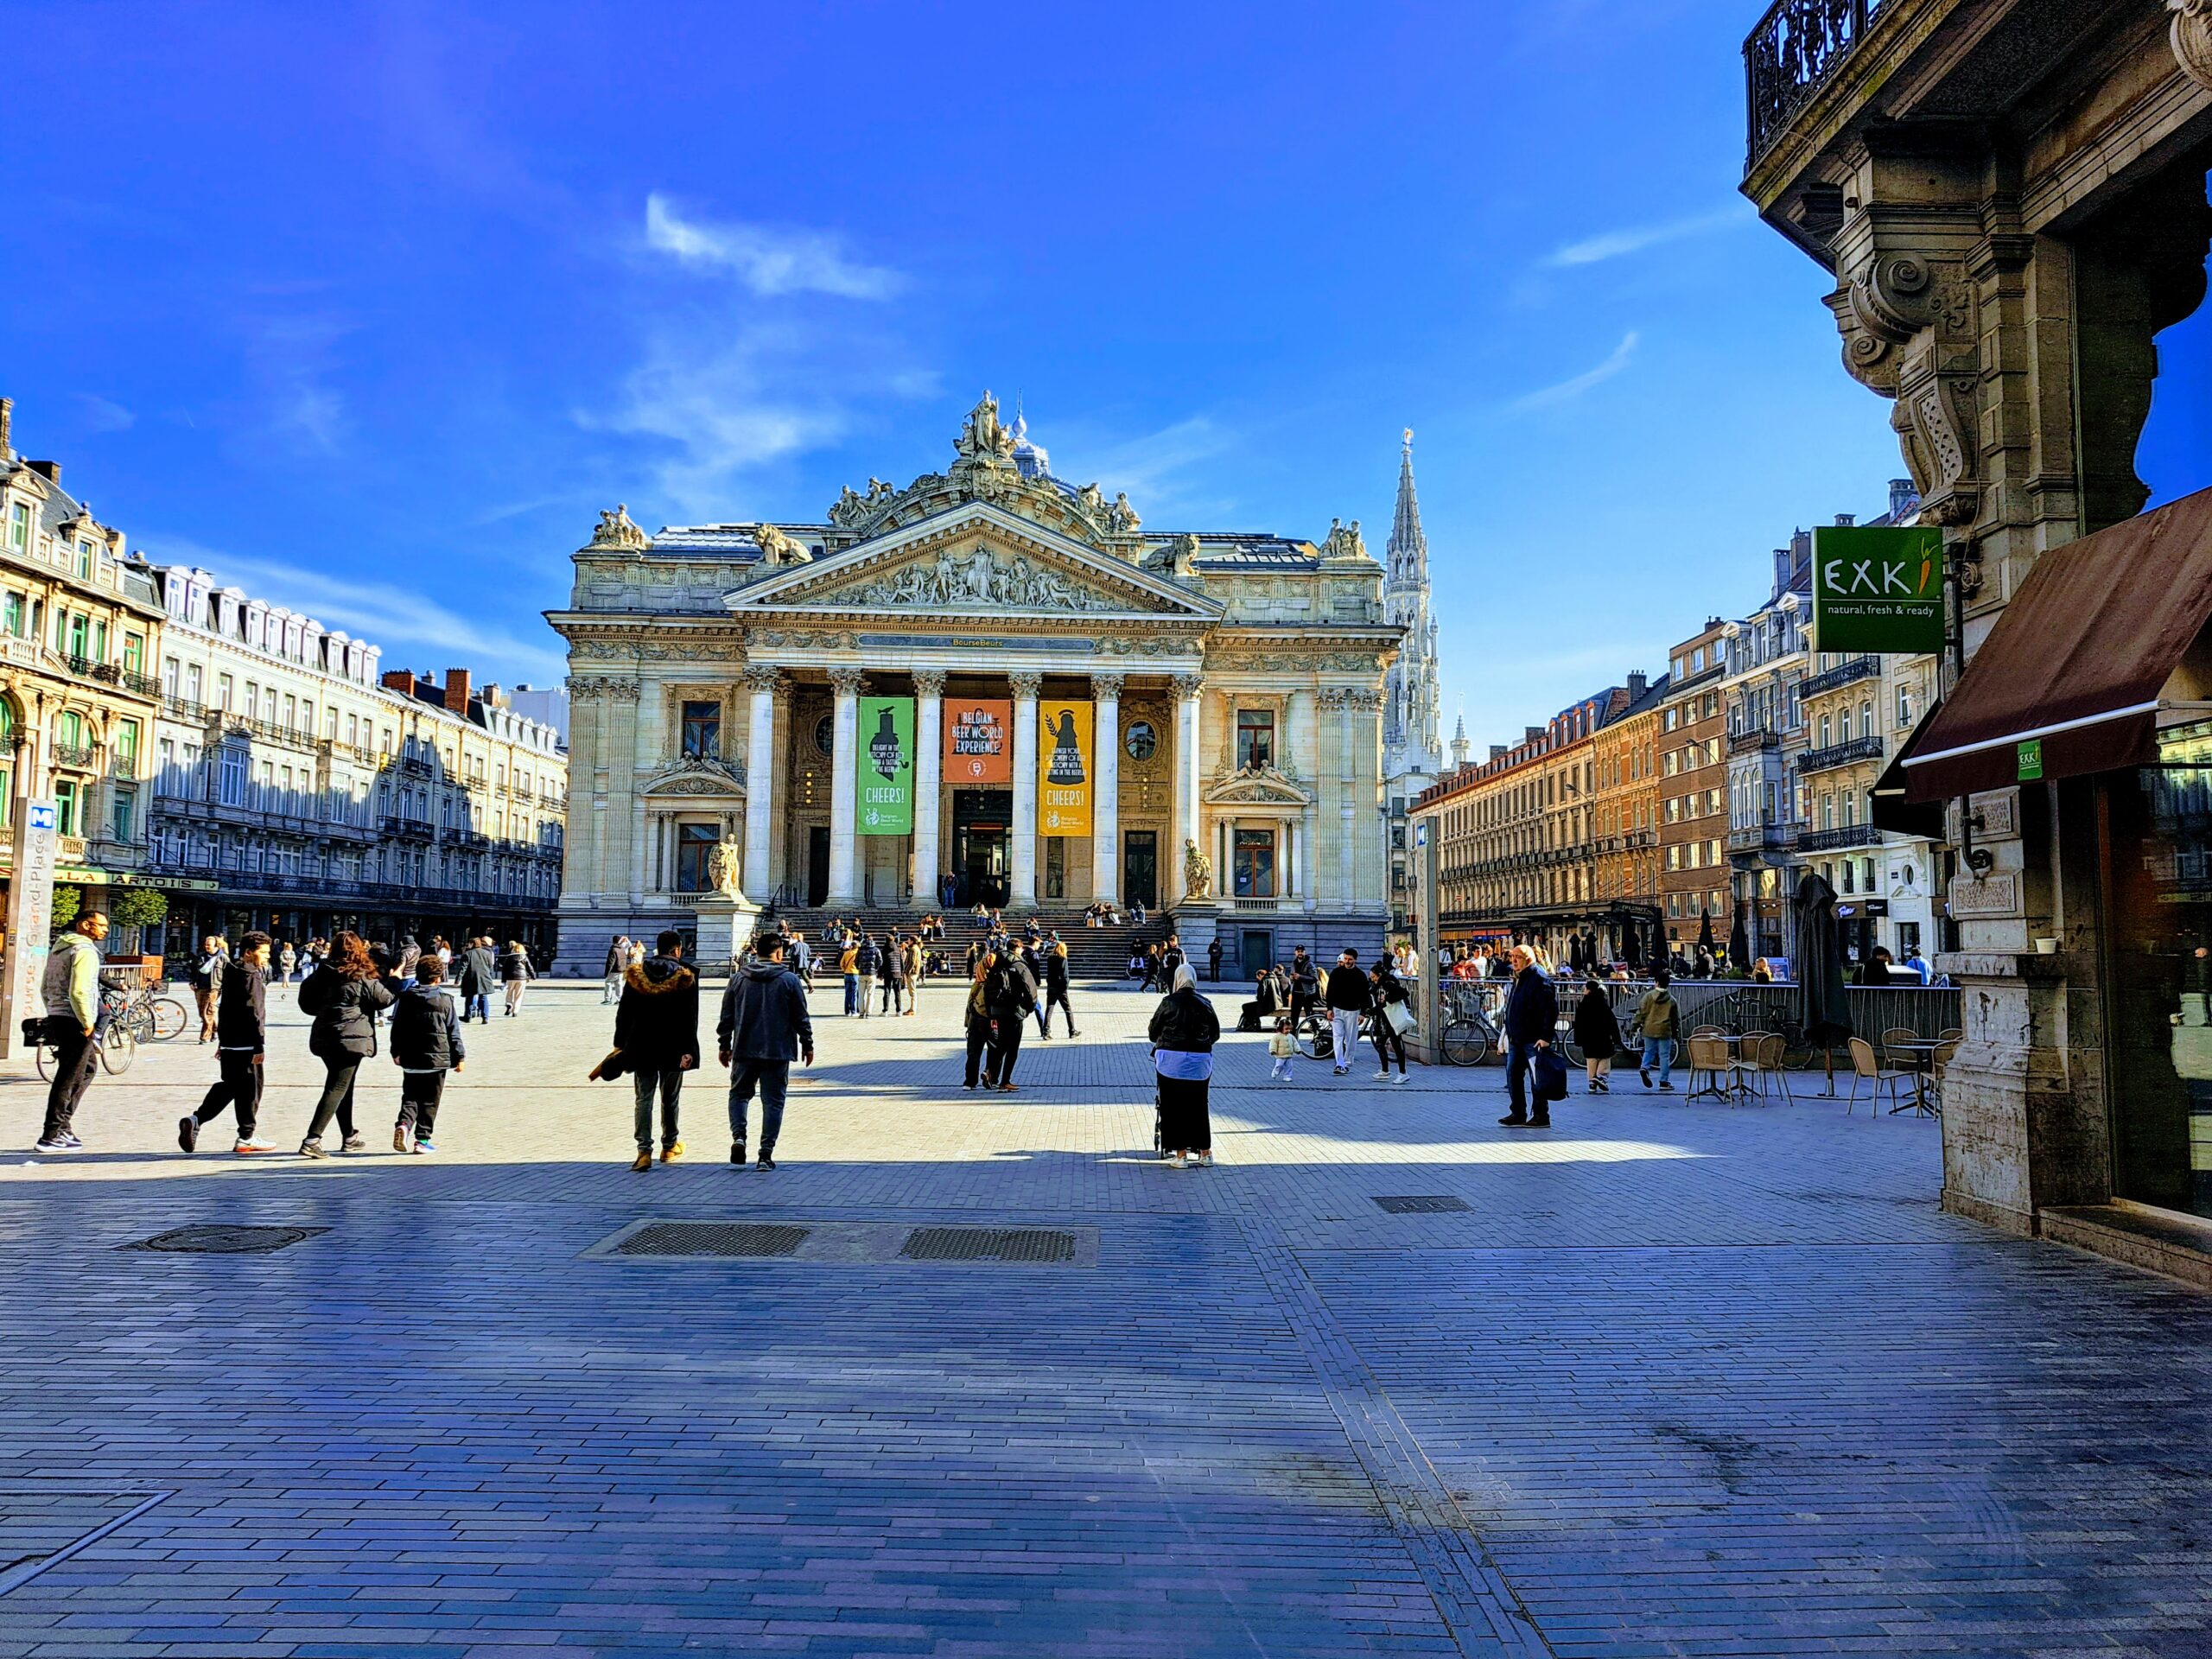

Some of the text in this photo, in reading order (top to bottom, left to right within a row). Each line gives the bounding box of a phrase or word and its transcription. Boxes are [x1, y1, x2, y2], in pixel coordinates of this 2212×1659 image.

[1827, 604, 1934, 618] natural, fresh & ready
[952, 638, 1003, 647] BourseBeurs
[951, 726, 1003, 739] BEER WORLD
[866, 787, 905, 804] CHEERS!
[1046, 789, 1084, 806] CHEERS!
[113, 874, 192, 888] ARTOIS
